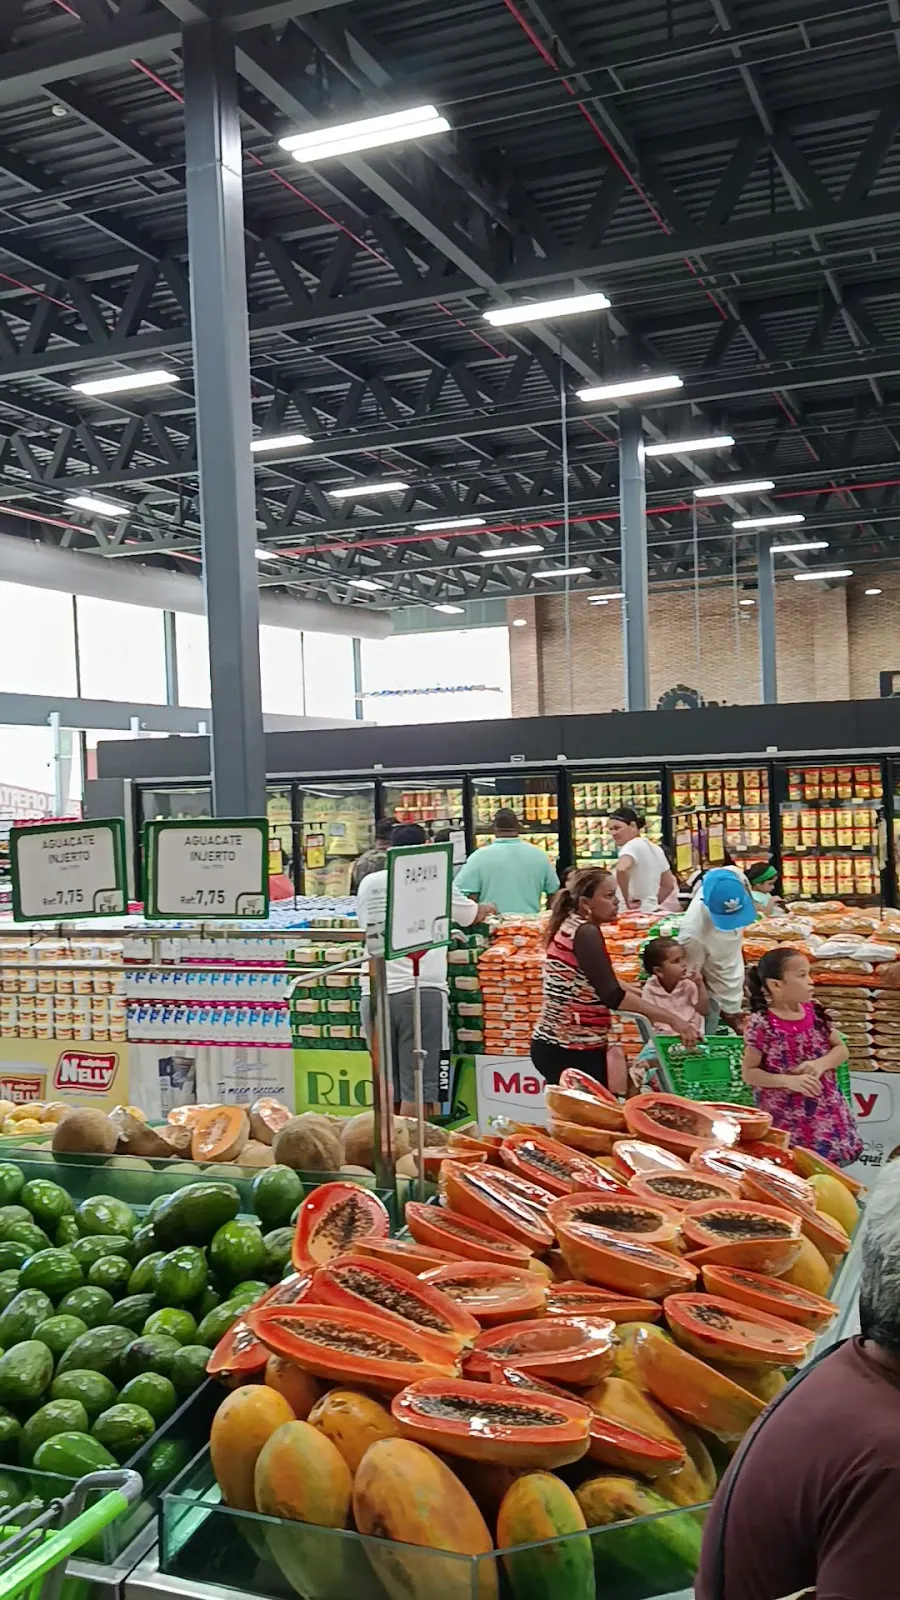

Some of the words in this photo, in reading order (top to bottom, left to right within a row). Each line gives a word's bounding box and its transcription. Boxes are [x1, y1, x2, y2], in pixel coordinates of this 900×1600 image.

[42, 834, 96, 850] AGUACATE
[184, 835, 243, 846] AGUACATE
[48, 850, 91, 864] INJERTO
[190, 851, 236, 861] INJERTO
[439, 1060, 450, 1090] SPORT
